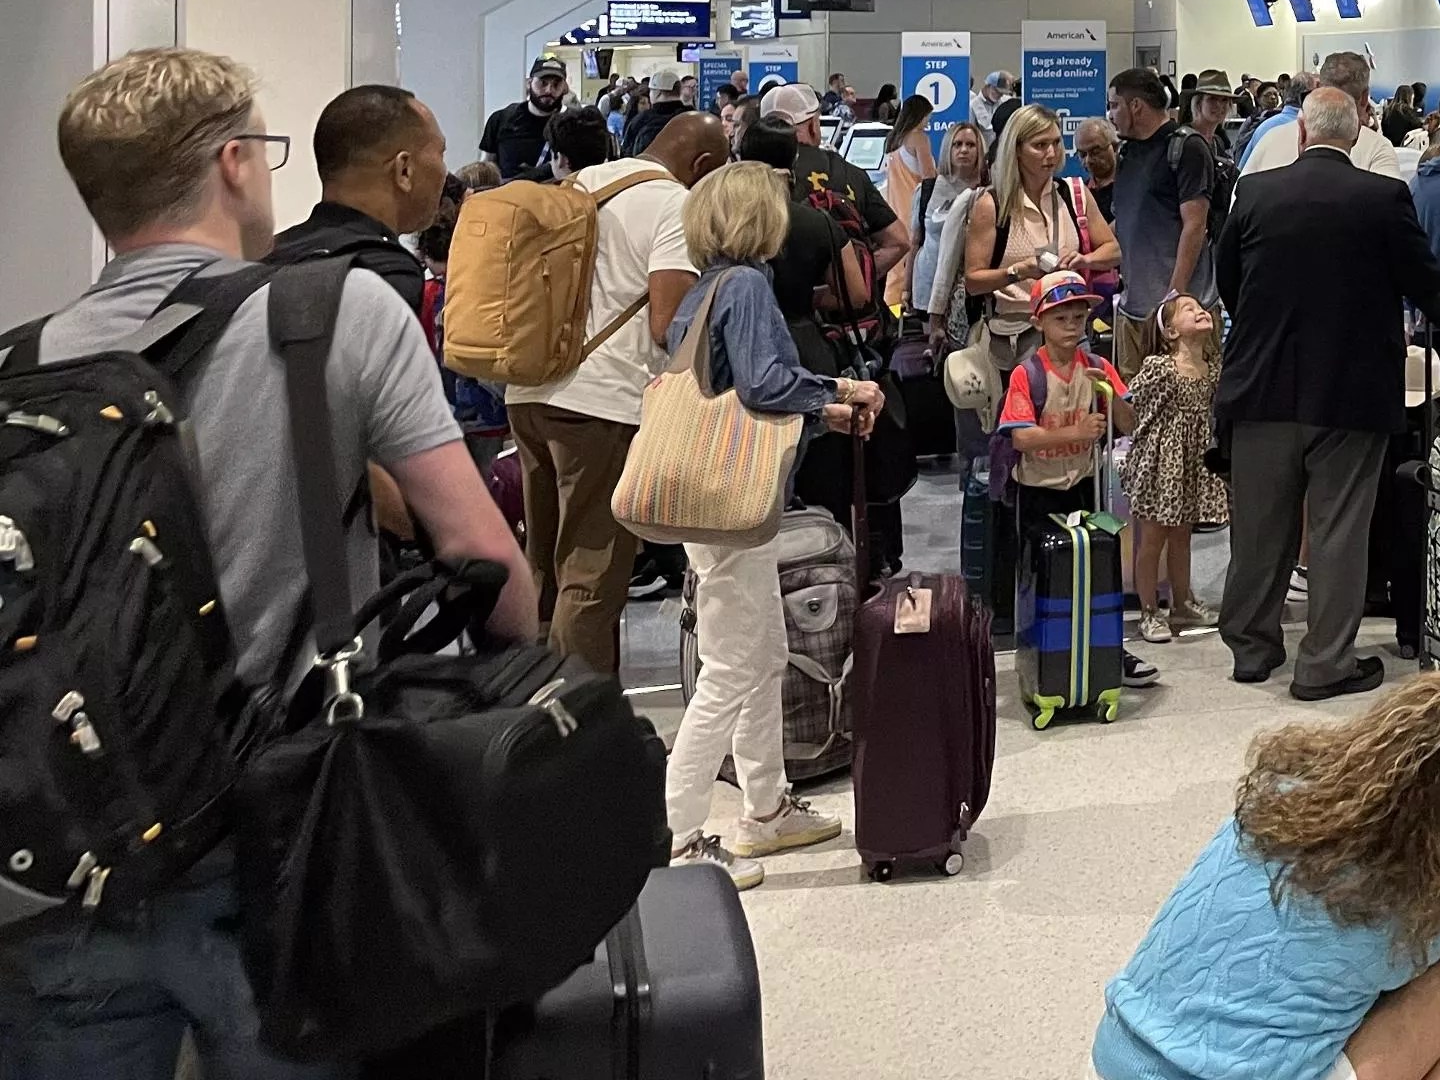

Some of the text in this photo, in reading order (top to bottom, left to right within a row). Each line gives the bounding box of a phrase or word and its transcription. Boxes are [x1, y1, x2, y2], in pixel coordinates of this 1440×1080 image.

[1047, 31, 1084, 39] American
[921, 40, 953, 48] American
[925, 60, 948, 70] STEP
[1031, 56, 1092, 68] Bags already
[1031, 68, 1098, 78] added online?
[929, 81, 940, 106] 1
